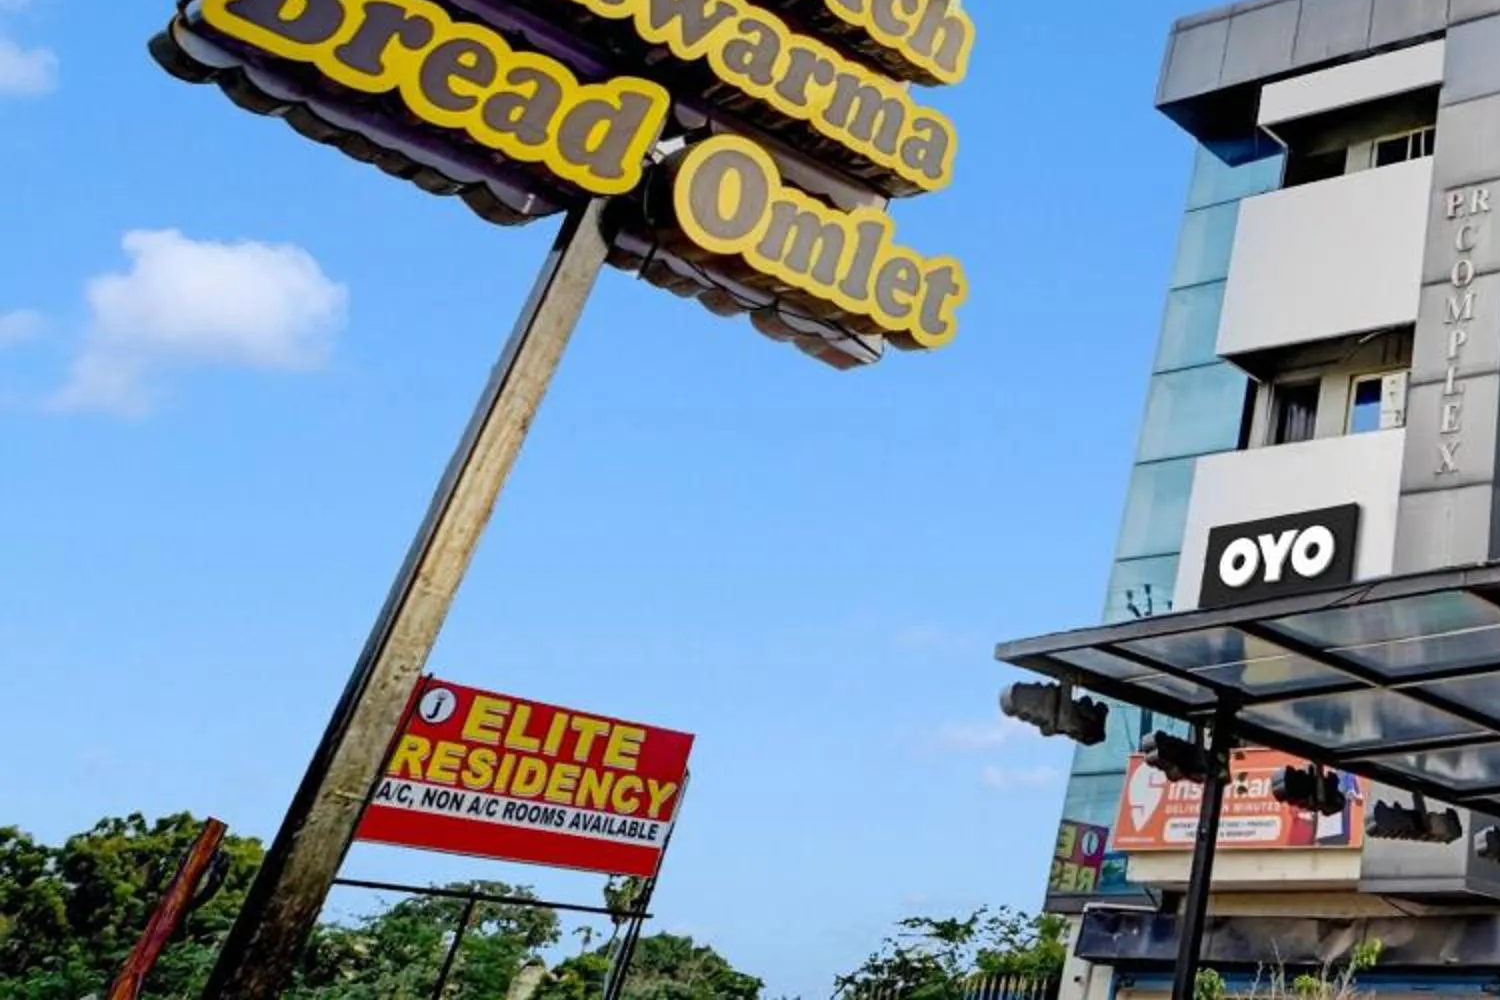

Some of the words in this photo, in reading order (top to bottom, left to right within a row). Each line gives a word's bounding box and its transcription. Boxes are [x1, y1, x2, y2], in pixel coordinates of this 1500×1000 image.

[687, 147, 961, 338] Omlet
[1435, 225, 1477, 476] COMPLEX
[1219, 525, 1336, 588] OYO
[461, 695, 646, 772] ELITE
[376, 780, 415, 808] A/C,
[421, 787, 466, 812] NON
[467, 795, 500, 817] A/C
[502, 801, 567, 828] ROOMS
[569, 812, 660, 841] AVAILABLE
[386, 733, 679, 819] RESIDENCY
